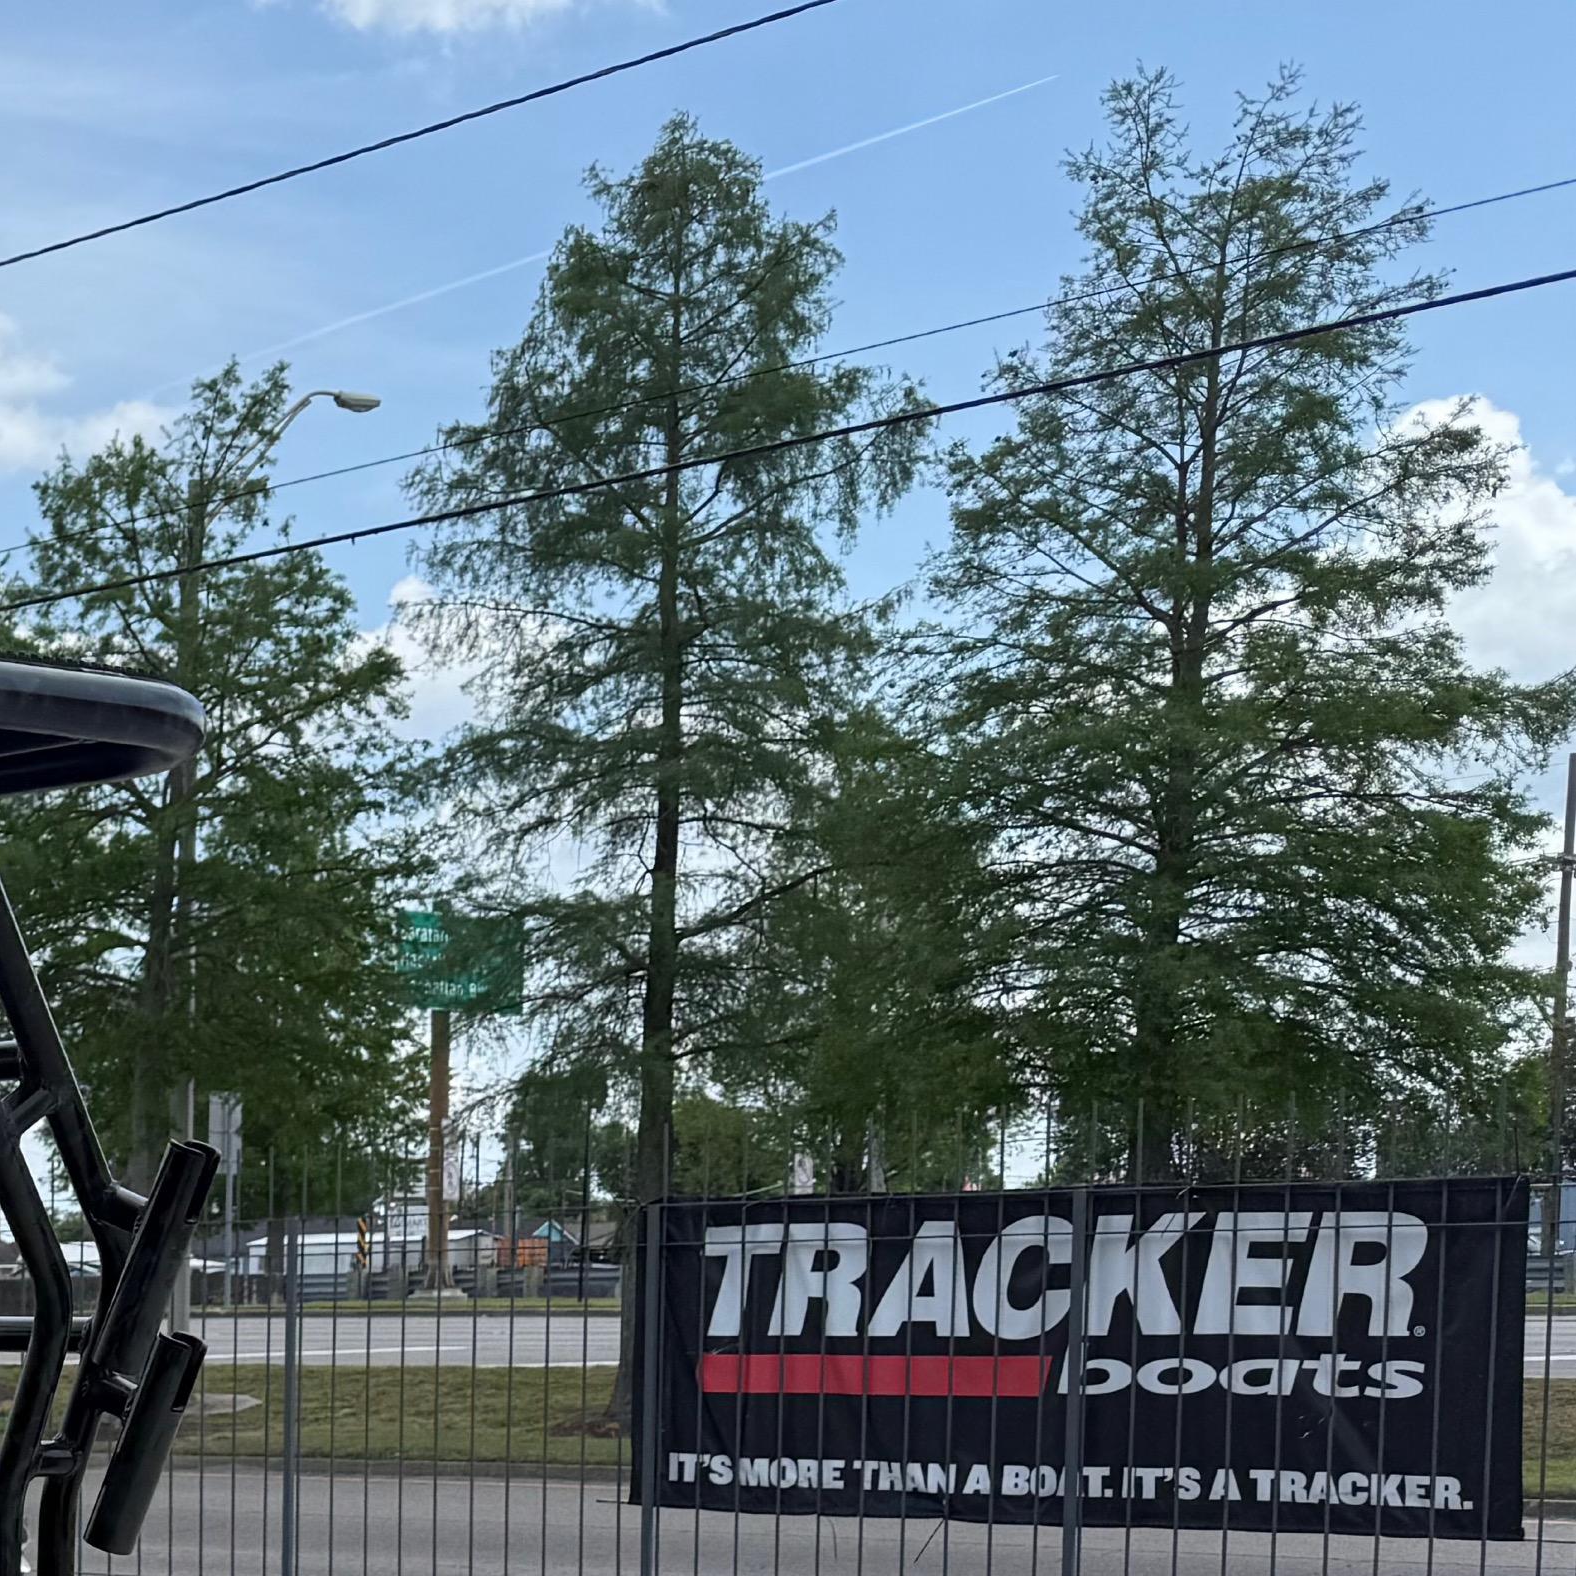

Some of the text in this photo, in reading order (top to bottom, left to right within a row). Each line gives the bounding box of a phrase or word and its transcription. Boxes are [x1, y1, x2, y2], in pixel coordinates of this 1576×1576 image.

[1057, 1343, 1426, 1399] boats
[668, 1452, 734, 1485] IT'S
[739, 1456, 846, 1490] MORE
[852, 1459, 957, 1494] THAN
[962, 1464, 991, 1495] A
[1122, 1465, 1201, 1501] IT'S
[1208, 1468, 1242, 1501] A
[1249, 1469, 1474, 1510] TRACKER.
